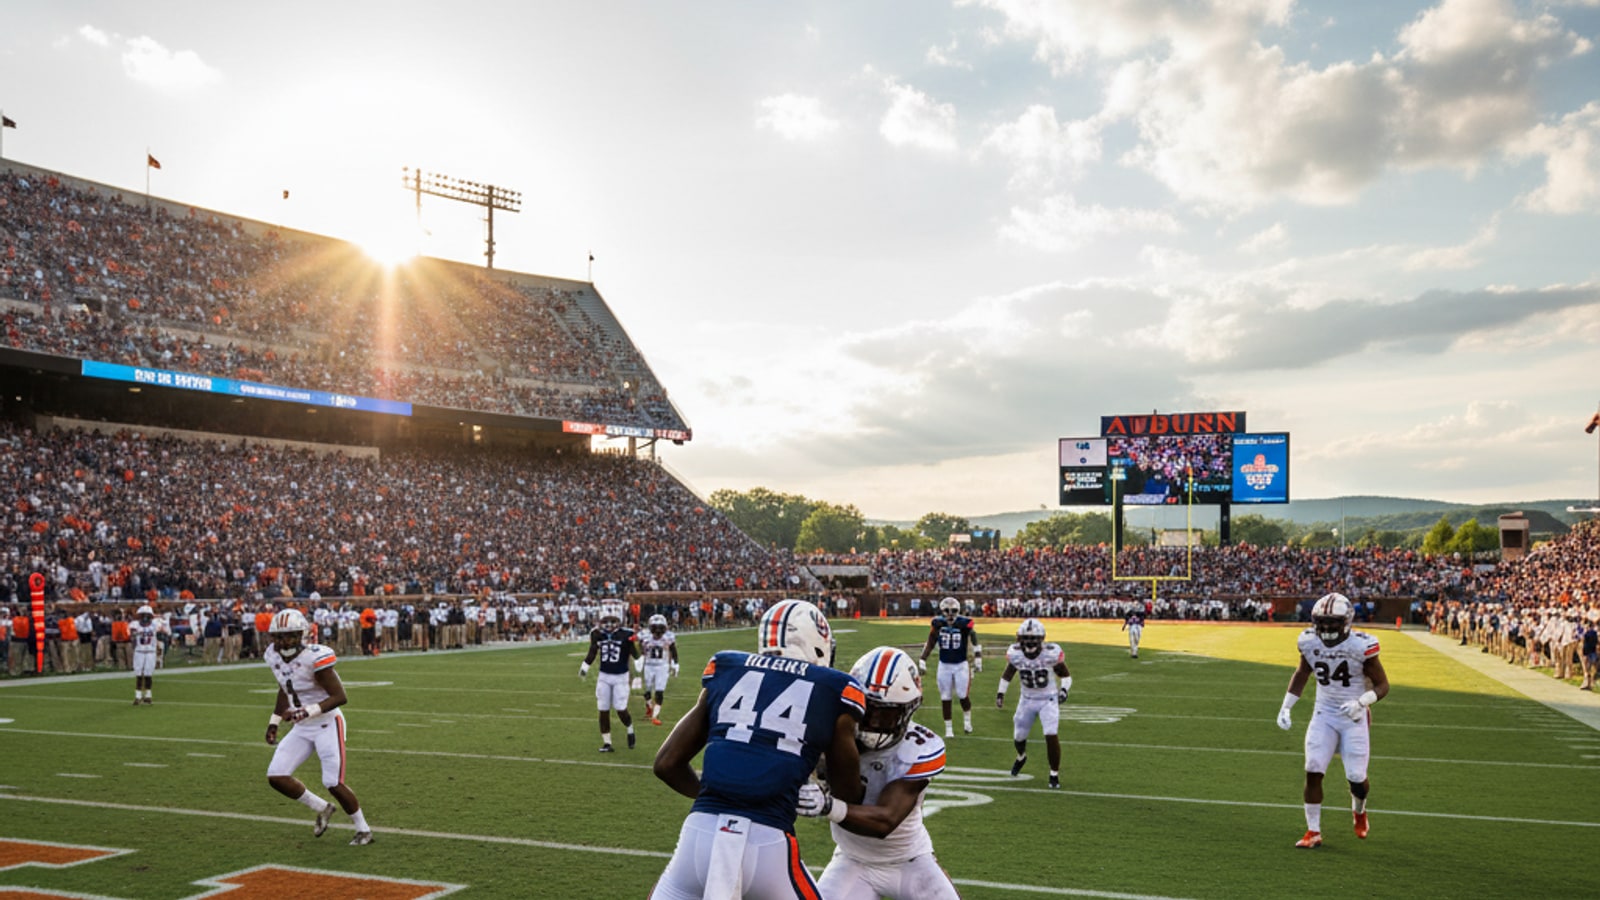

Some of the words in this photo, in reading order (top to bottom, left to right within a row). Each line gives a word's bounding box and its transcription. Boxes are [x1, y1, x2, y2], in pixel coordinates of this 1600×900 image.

[1106, 412, 1236, 434] AUBURN
[1314, 660, 1353, 687] 34
[717, 670, 815, 756] 44
